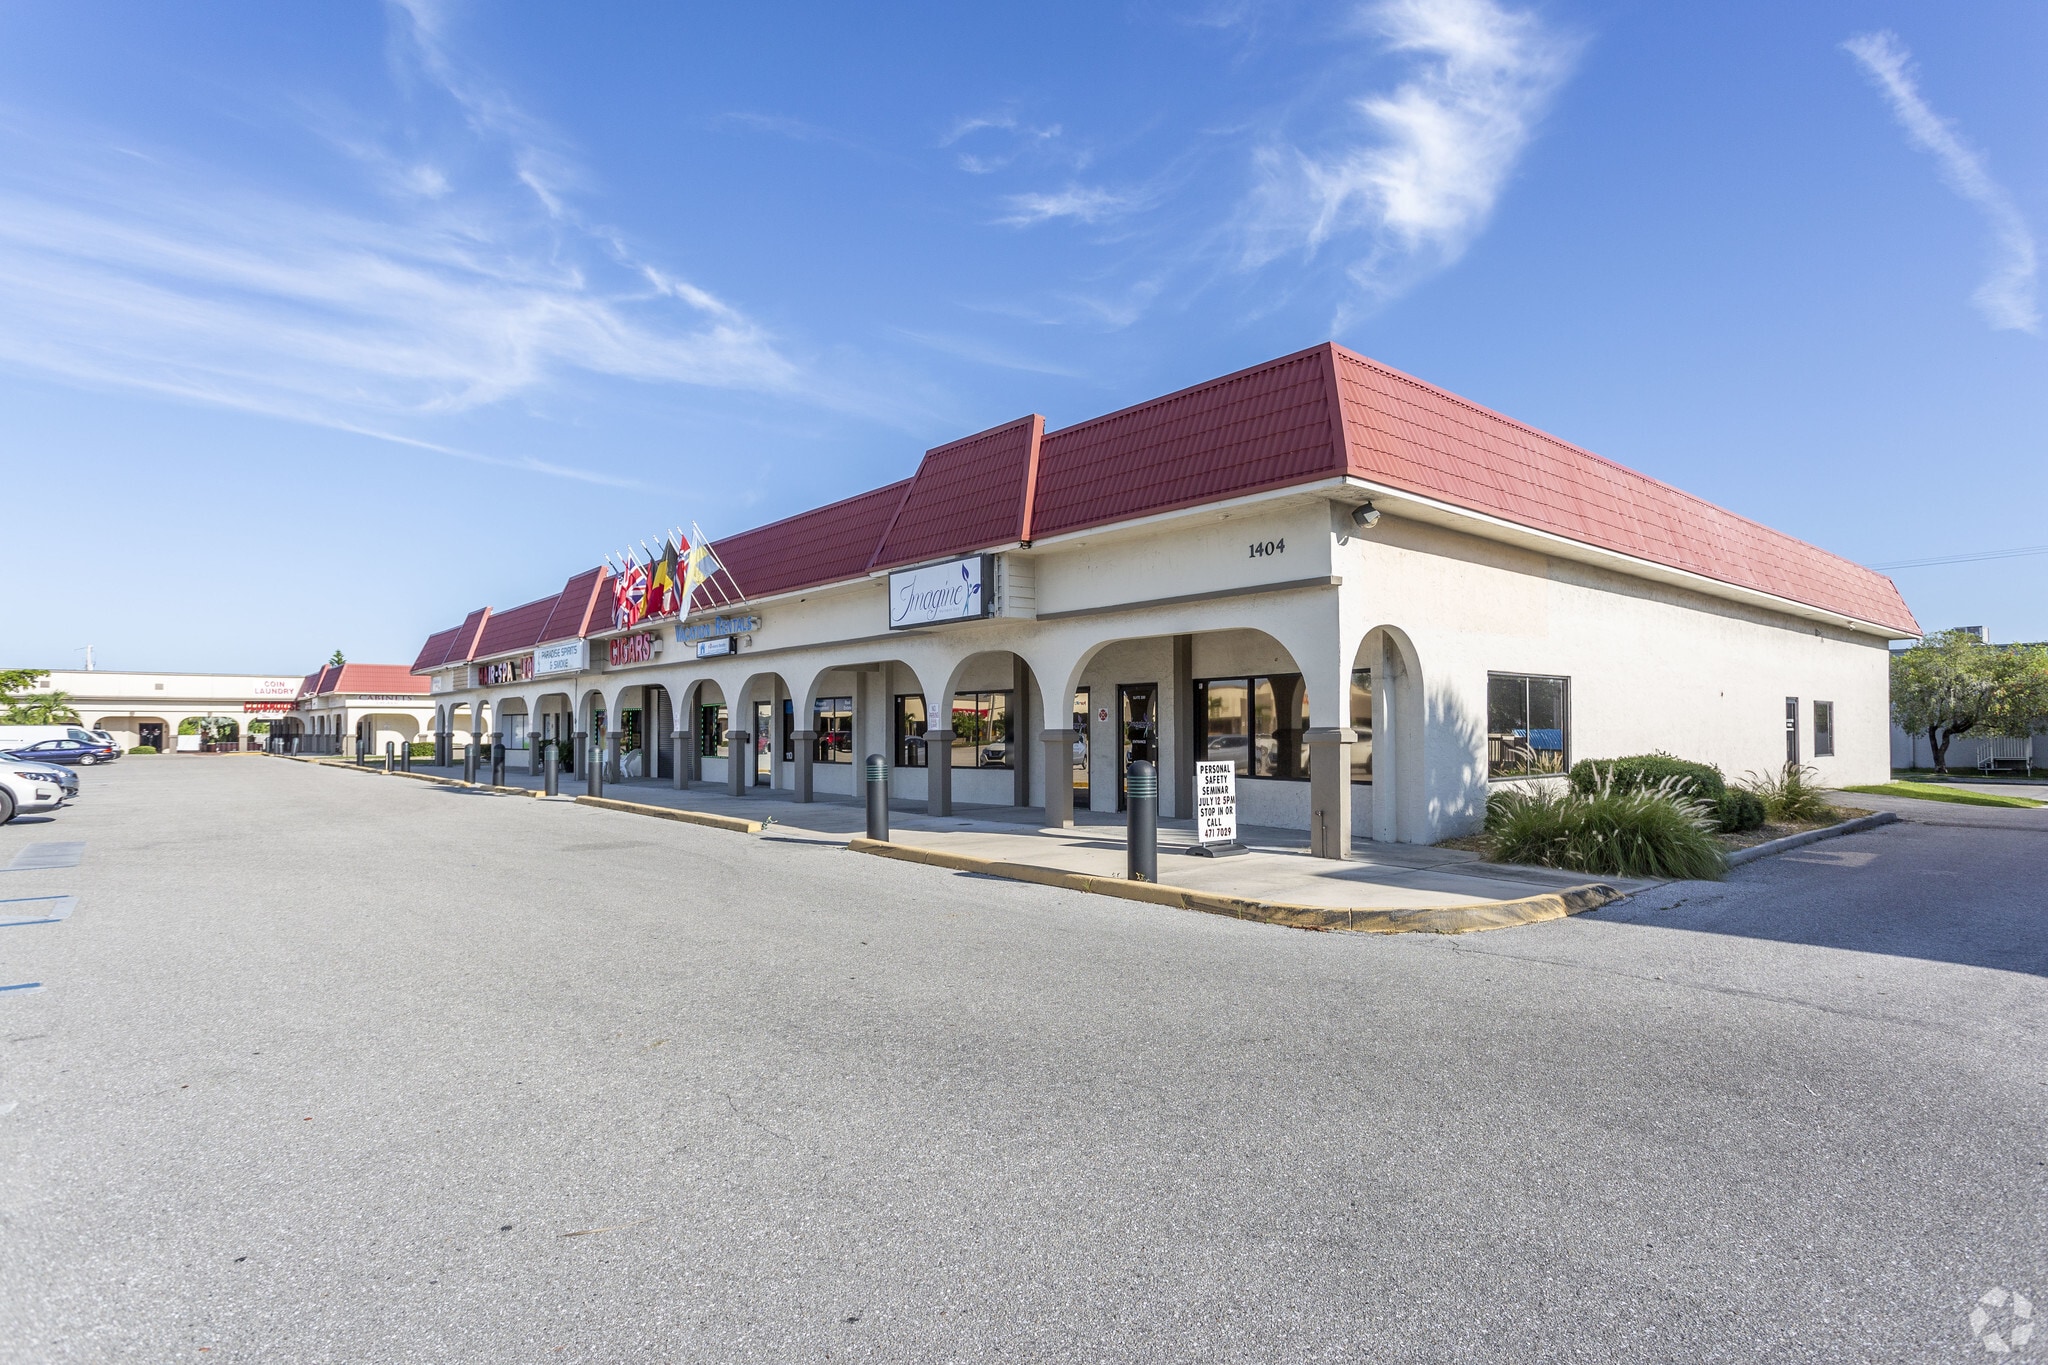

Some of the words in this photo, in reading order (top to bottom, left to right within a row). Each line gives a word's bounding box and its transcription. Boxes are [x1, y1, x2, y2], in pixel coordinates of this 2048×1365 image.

[1249, 537, 1285, 558] 1404
[892, 575, 963, 621] Imagine
[541, 648, 560, 659] PARADISE
[560, 645, 577, 656] SPIRITS
[609, 631, 651, 666] CIGARS
[553, 658, 569, 669] SMOKE
[1200, 764, 1231, 774] PERSONAL
[1205, 775, 1227, 784] SAFETY
[1202, 785, 1228, 795] SEMINAR
[1199, 796, 1213, 807] JULY
[1215, 796, 1221, 805] 12
[1223, 795, 1235, 805] 5PM
[1201, 807, 1215, 817] STOP
[1218, 806, 1223, 816] IN
[1225, 805, 1233, 815] OR
[1207, 818, 1222, 827] CALL
[1205, 829, 1215, 838] 471
[1217, 827, 1231, 837] 7029
